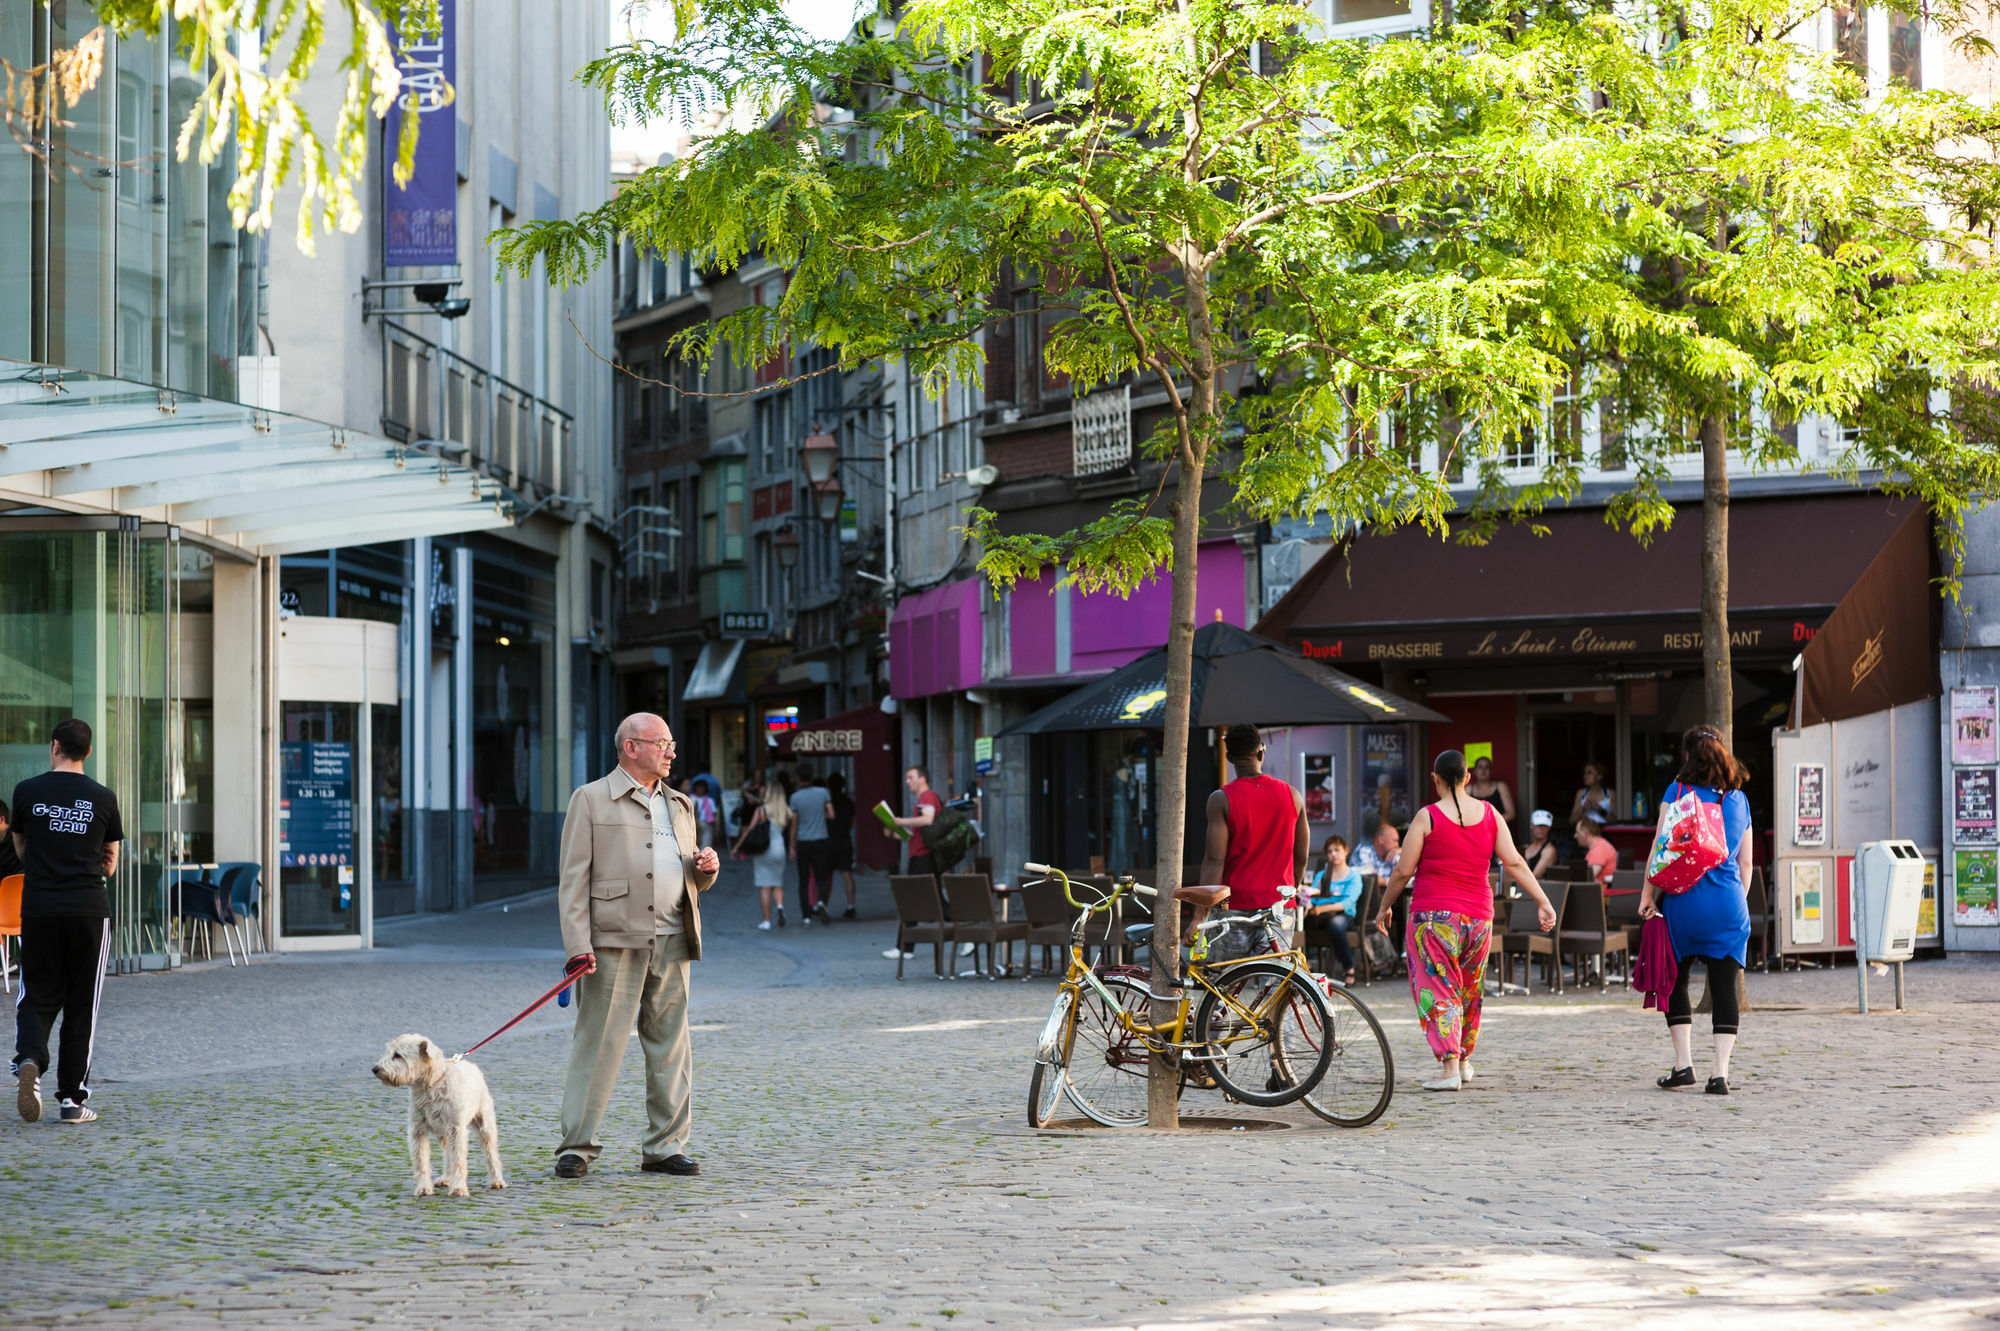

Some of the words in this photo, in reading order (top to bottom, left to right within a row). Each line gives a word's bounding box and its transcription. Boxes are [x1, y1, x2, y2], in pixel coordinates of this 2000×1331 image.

[726, 615, 765, 629] BASE
[1467, 631, 1497, 656] Le
[1663, 630, 1762, 649] RESTANT
[1301, 640, 1343, 659] Duvel
[1368, 642, 1443, 659] BRASSERIE
[791, 730, 863, 752] ANDRE
[1367, 733, 1398, 752] MAES
[49, 819, 87, 835] RAW
